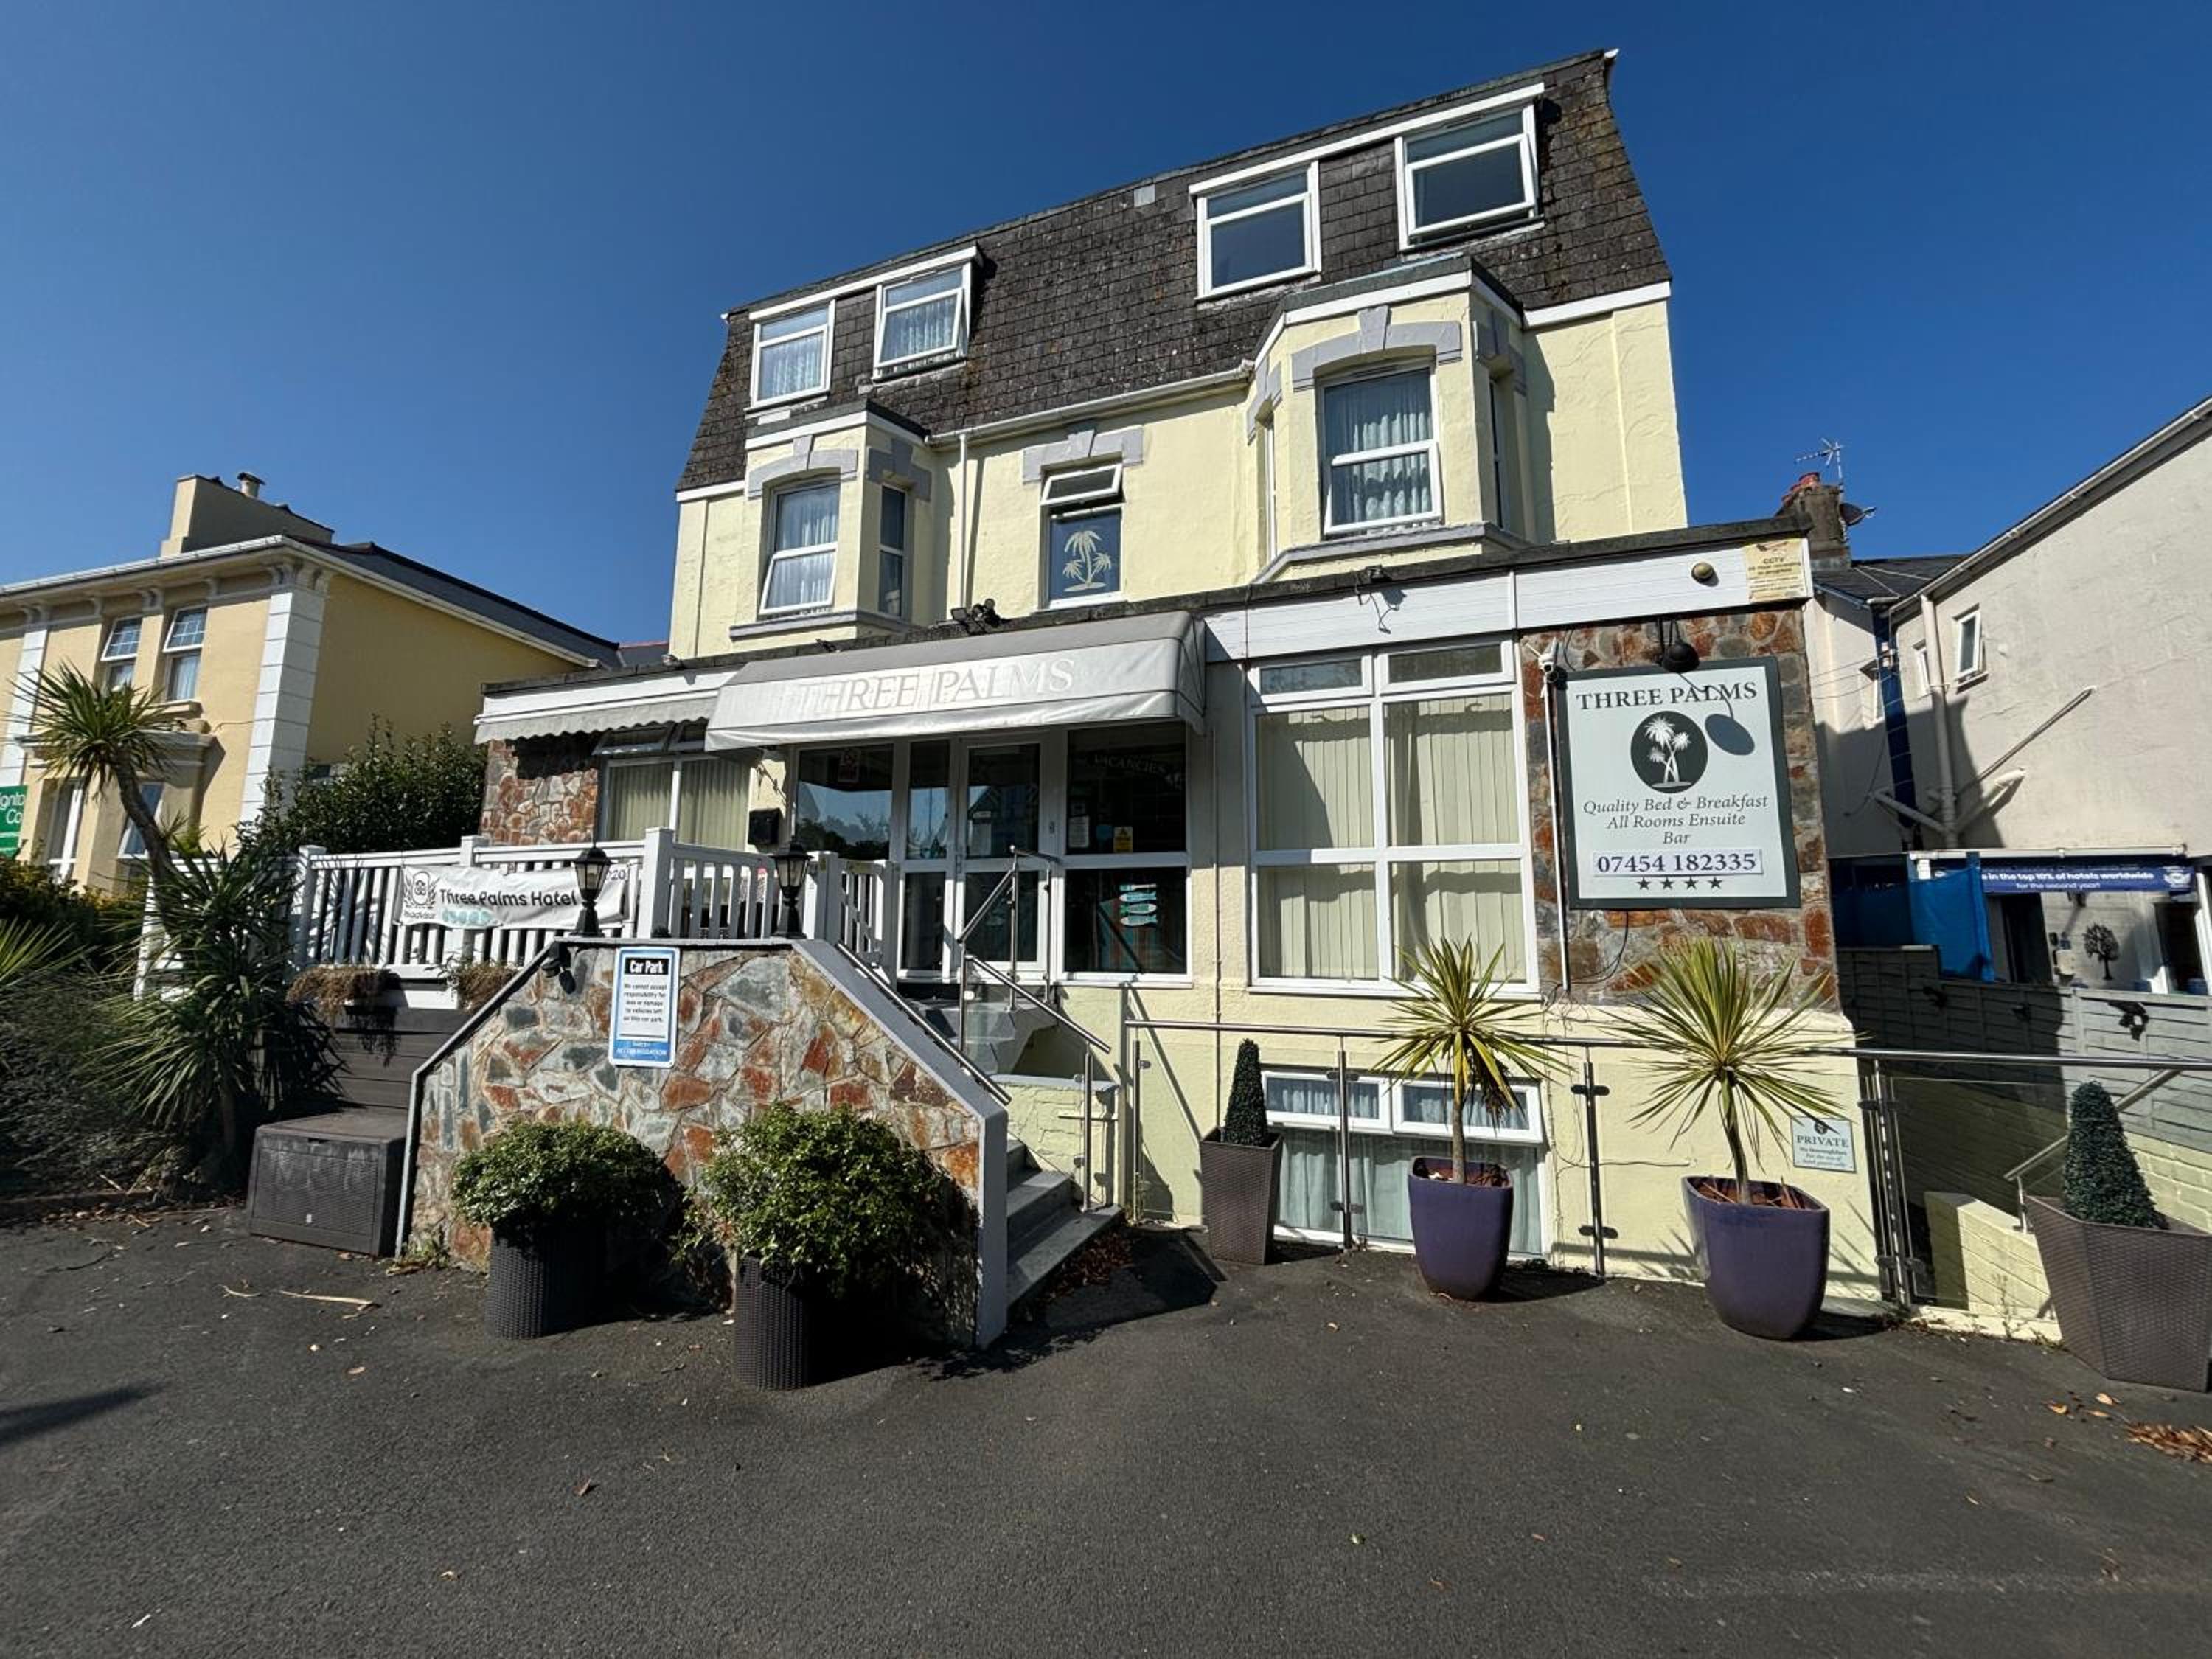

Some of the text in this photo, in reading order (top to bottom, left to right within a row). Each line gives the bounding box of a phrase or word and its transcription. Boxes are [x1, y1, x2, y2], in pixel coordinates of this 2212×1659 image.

[933, 658, 1074, 703] PALMS
[1576, 682, 1758, 710] THREE PALMS
[1583, 794, 1769, 815] Quality Bed & Breakfast
[1605, 813, 1746, 830] All Rooms Ensuite
[1663, 831, 1691, 845] Bar
[1596, 853, 1756, 873] 07454 182335
[2017, 873, 2035, 881] top
[2100, 872, 2154, 880] worldwide
[439, 888, 578, 906] Three Palms Hotel
[630, 960, 664, 973] Car Park
[1797, 1135, 1849, 1148] PRIVATE
